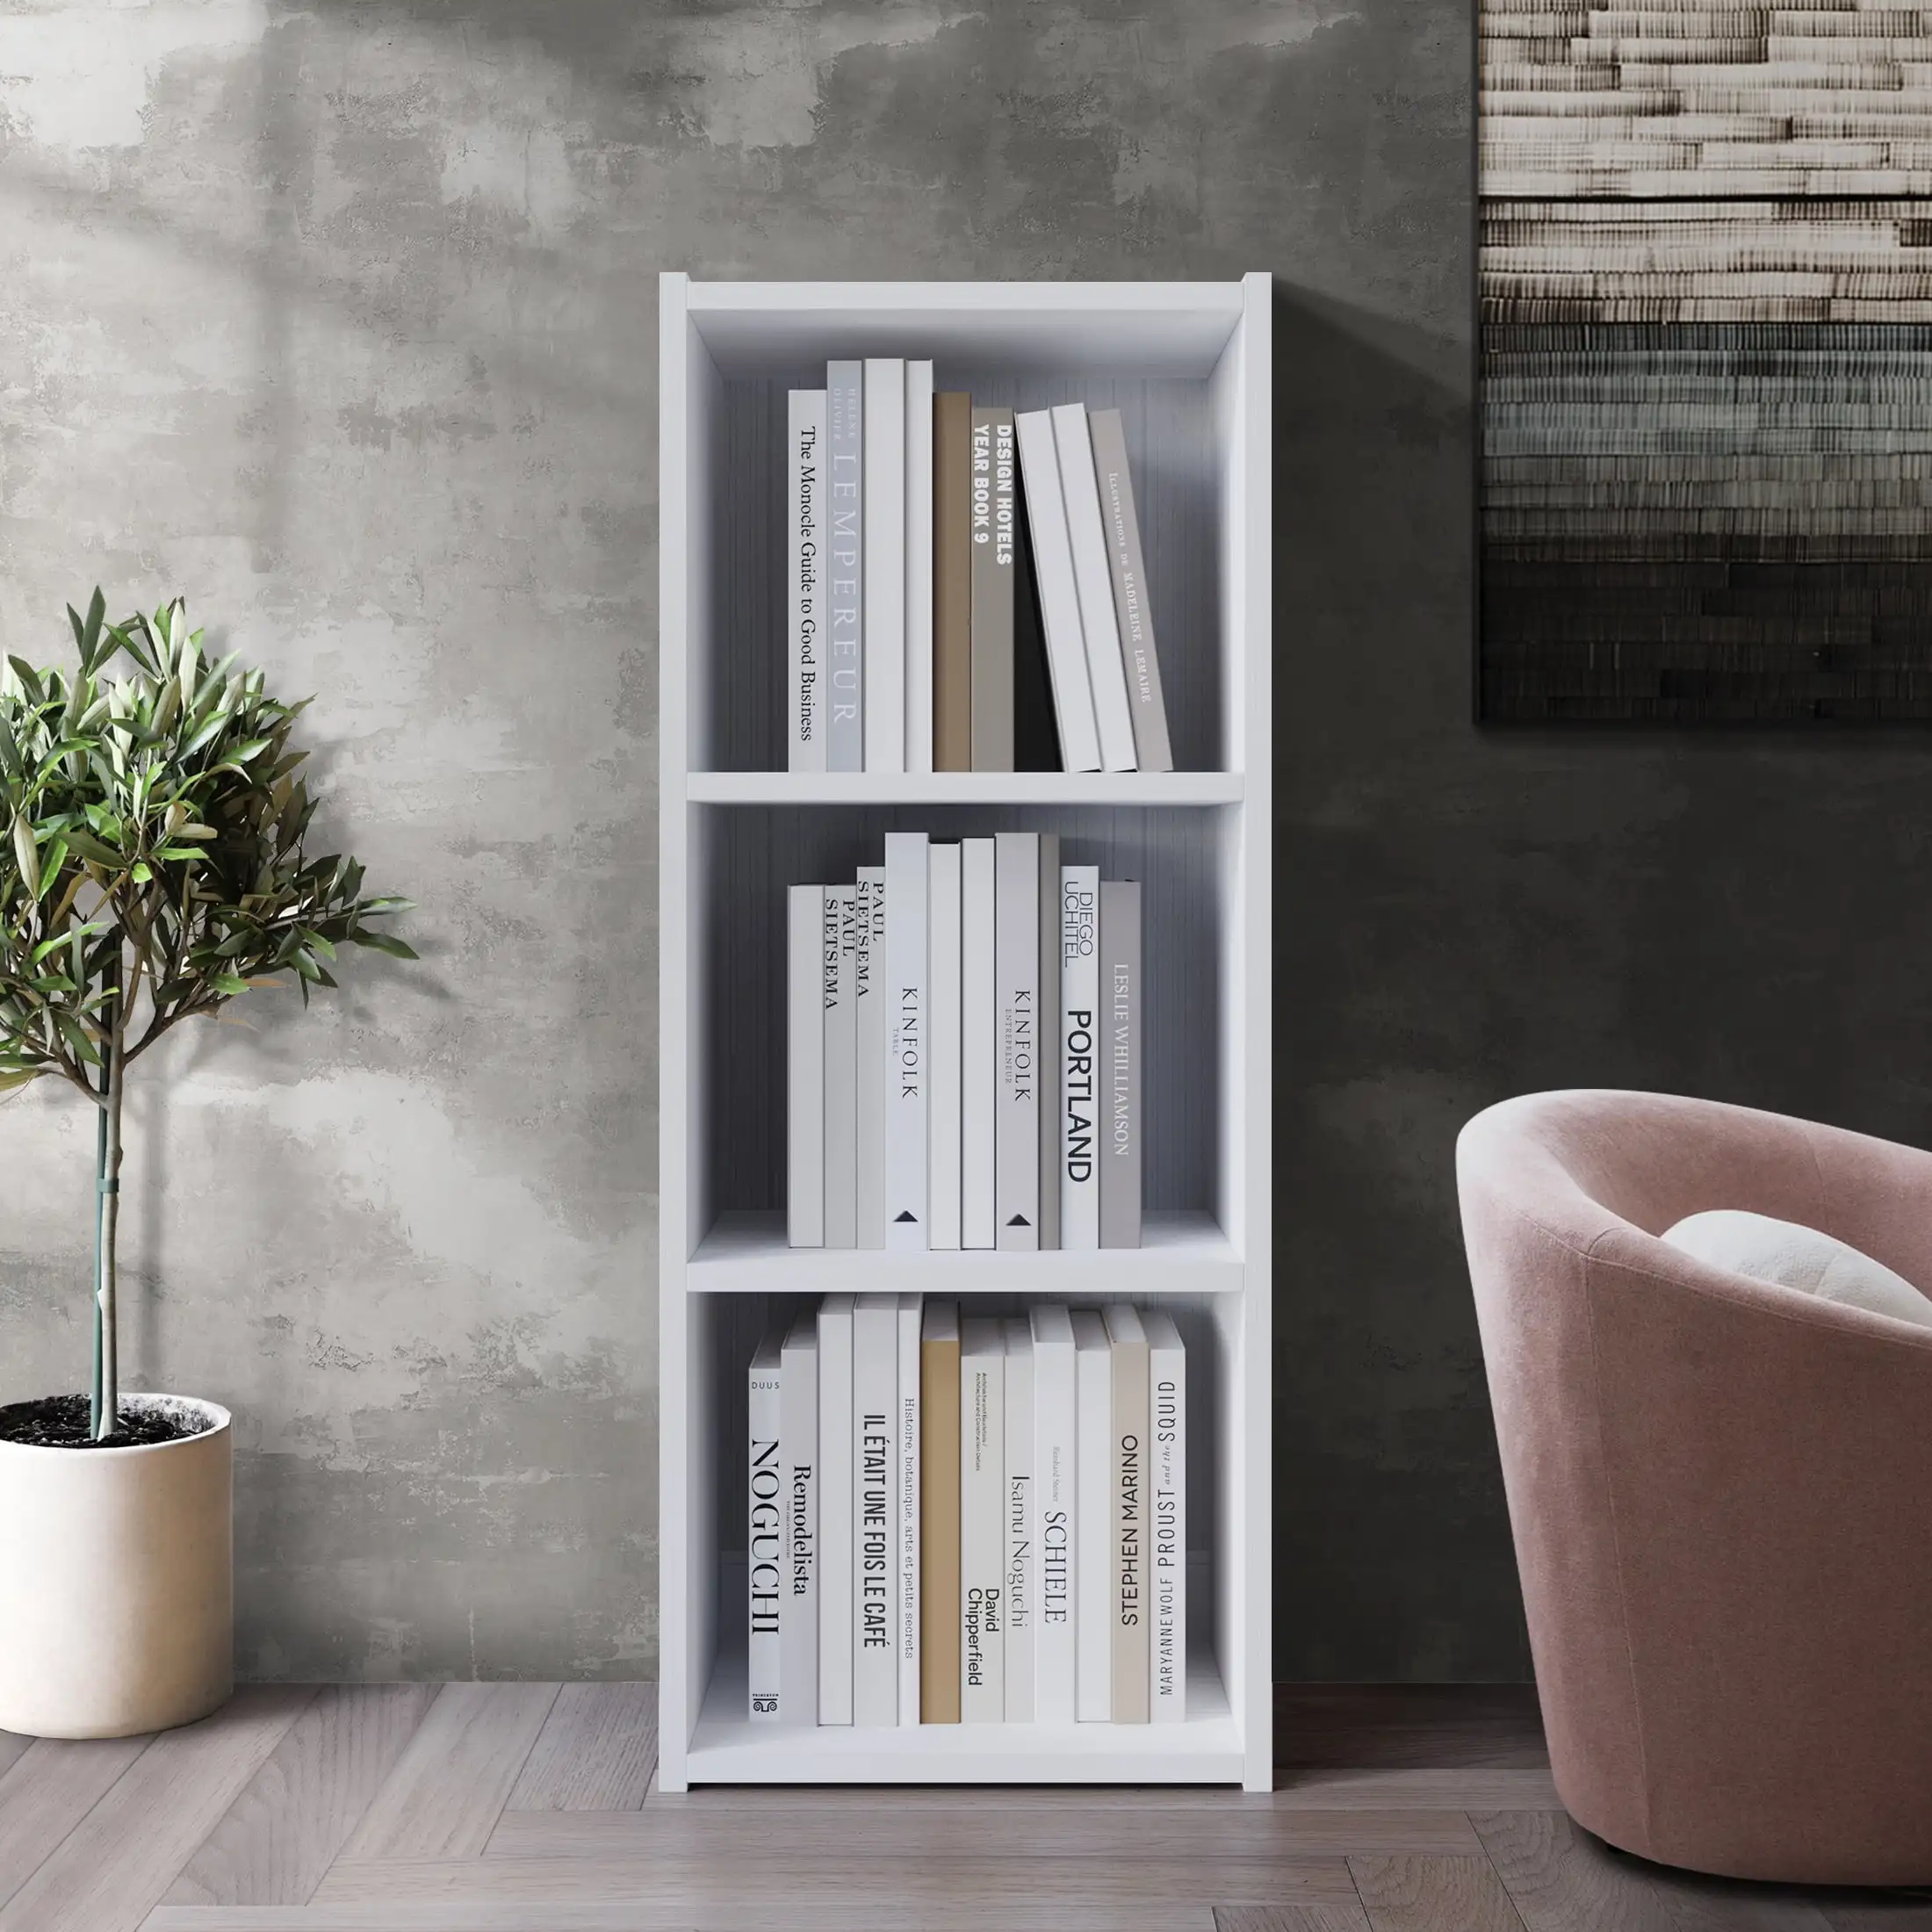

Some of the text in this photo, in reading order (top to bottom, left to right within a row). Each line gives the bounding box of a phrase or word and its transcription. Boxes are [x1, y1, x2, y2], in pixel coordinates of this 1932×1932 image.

[974, 424, 989, 543] YEAR BOOK 9
[997, 425, 1012, 564] DESIGN HOTELS
[801, 426, 816, 740] The Monocle Guide to Good Business
[833, 455, 856, 723] LEMPEREUR
[1122, 573, 1142, 641] MADELEINE
[1135, 650, 1150, 703] LEMAIRE
[825, 898, 838, 1010] SIETSEMA
[843, 900, 854, 956] PAUL
[858, 881, 869, 997] SIETSEMA
[873, 882, 883, 941] PAUL
[1065, 881, 1078, 967] UCHITEL
[1079, 892, 1093, 955] DIEGO
[903, 989, 918, 1097] KINFOLK
[1015, 991, 1030, 1100] KINFOLK
[1068, 1011, 1092, 1182] PORTLAND
[1114, 965, 1128, 1155] LESLIE WHILLIAMSON
[905, 1398, 914, 1452] Histoire,
[1158, 1382, 1176, 1441] SQUID
[904, 1457, 913, 1521] botanique,
[1157, 1489, 1174, 1566] PROUST
[1162, 1463, 1171, 1485] and
[752, 1439, 779, 1633] NOGUCHI
[794, 1466, 812, 1595] Remodelista
[864, 1416, 890, 1647] IL ÉTAIT UNE FOIS LE CAFÉ
[905, 1557, 913, 1568] et
[1008, 1476, 1029, 1626] Isamu Noguchi
[1045, 1512, 1066, 1623] SCHIELE
[1121, 1436, 1137, 1626] STEPHEN MARINO
[904, 1574, 913, 1608] petits
[965, 1589, 982, 1685] Chipperfield
[985, 1589, 999, 1632] David
[1160, 1578, 1172, 1694] MARYANNE WOLF
